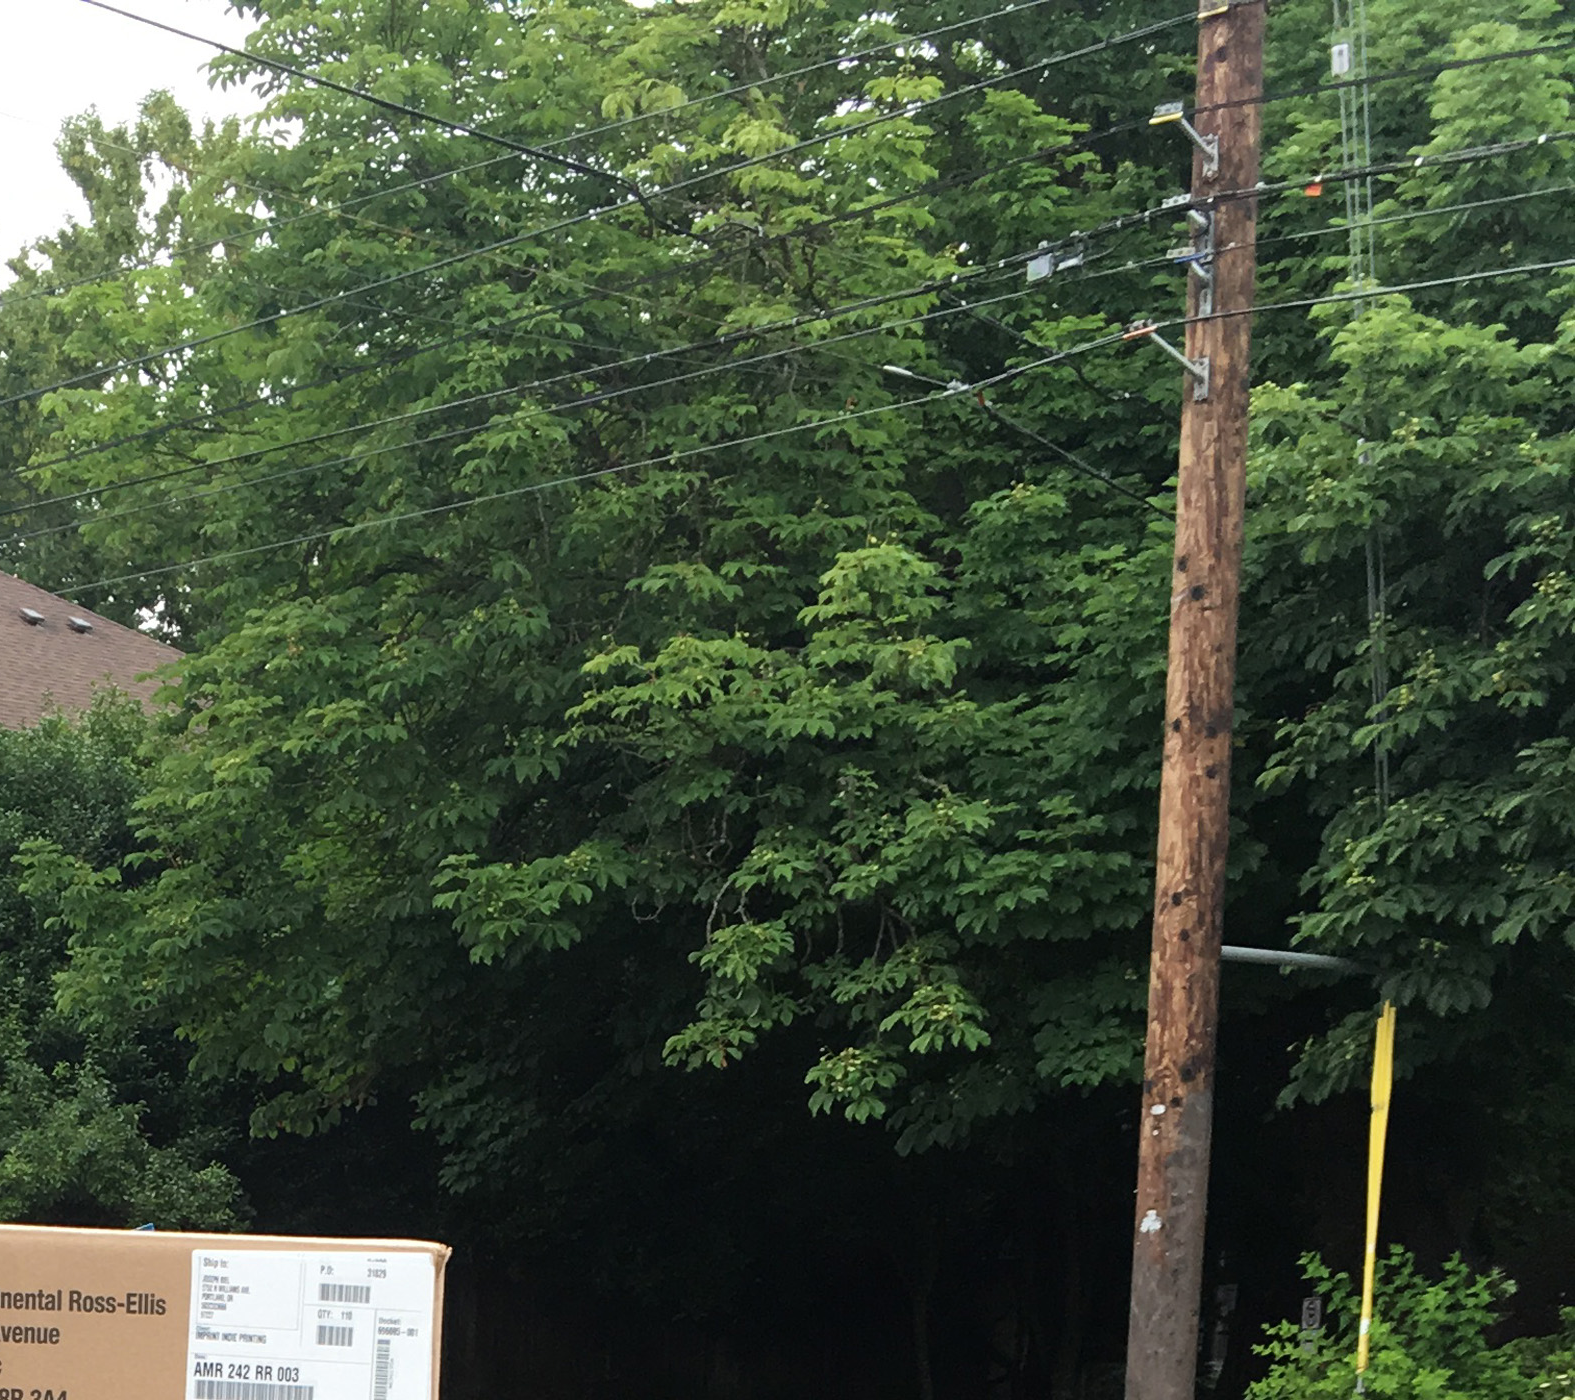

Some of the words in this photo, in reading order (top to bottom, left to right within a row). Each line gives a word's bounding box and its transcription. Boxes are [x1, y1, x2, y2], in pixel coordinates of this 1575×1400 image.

[68, 1290, 167, 1316] Ross-Ellis
[193, 1361, 223, 1379] AMR
[228, 1363, 251, 1380] 242
[255, 1365, 273, 1381] RR
[277, 1366, 300, 1383] 003
